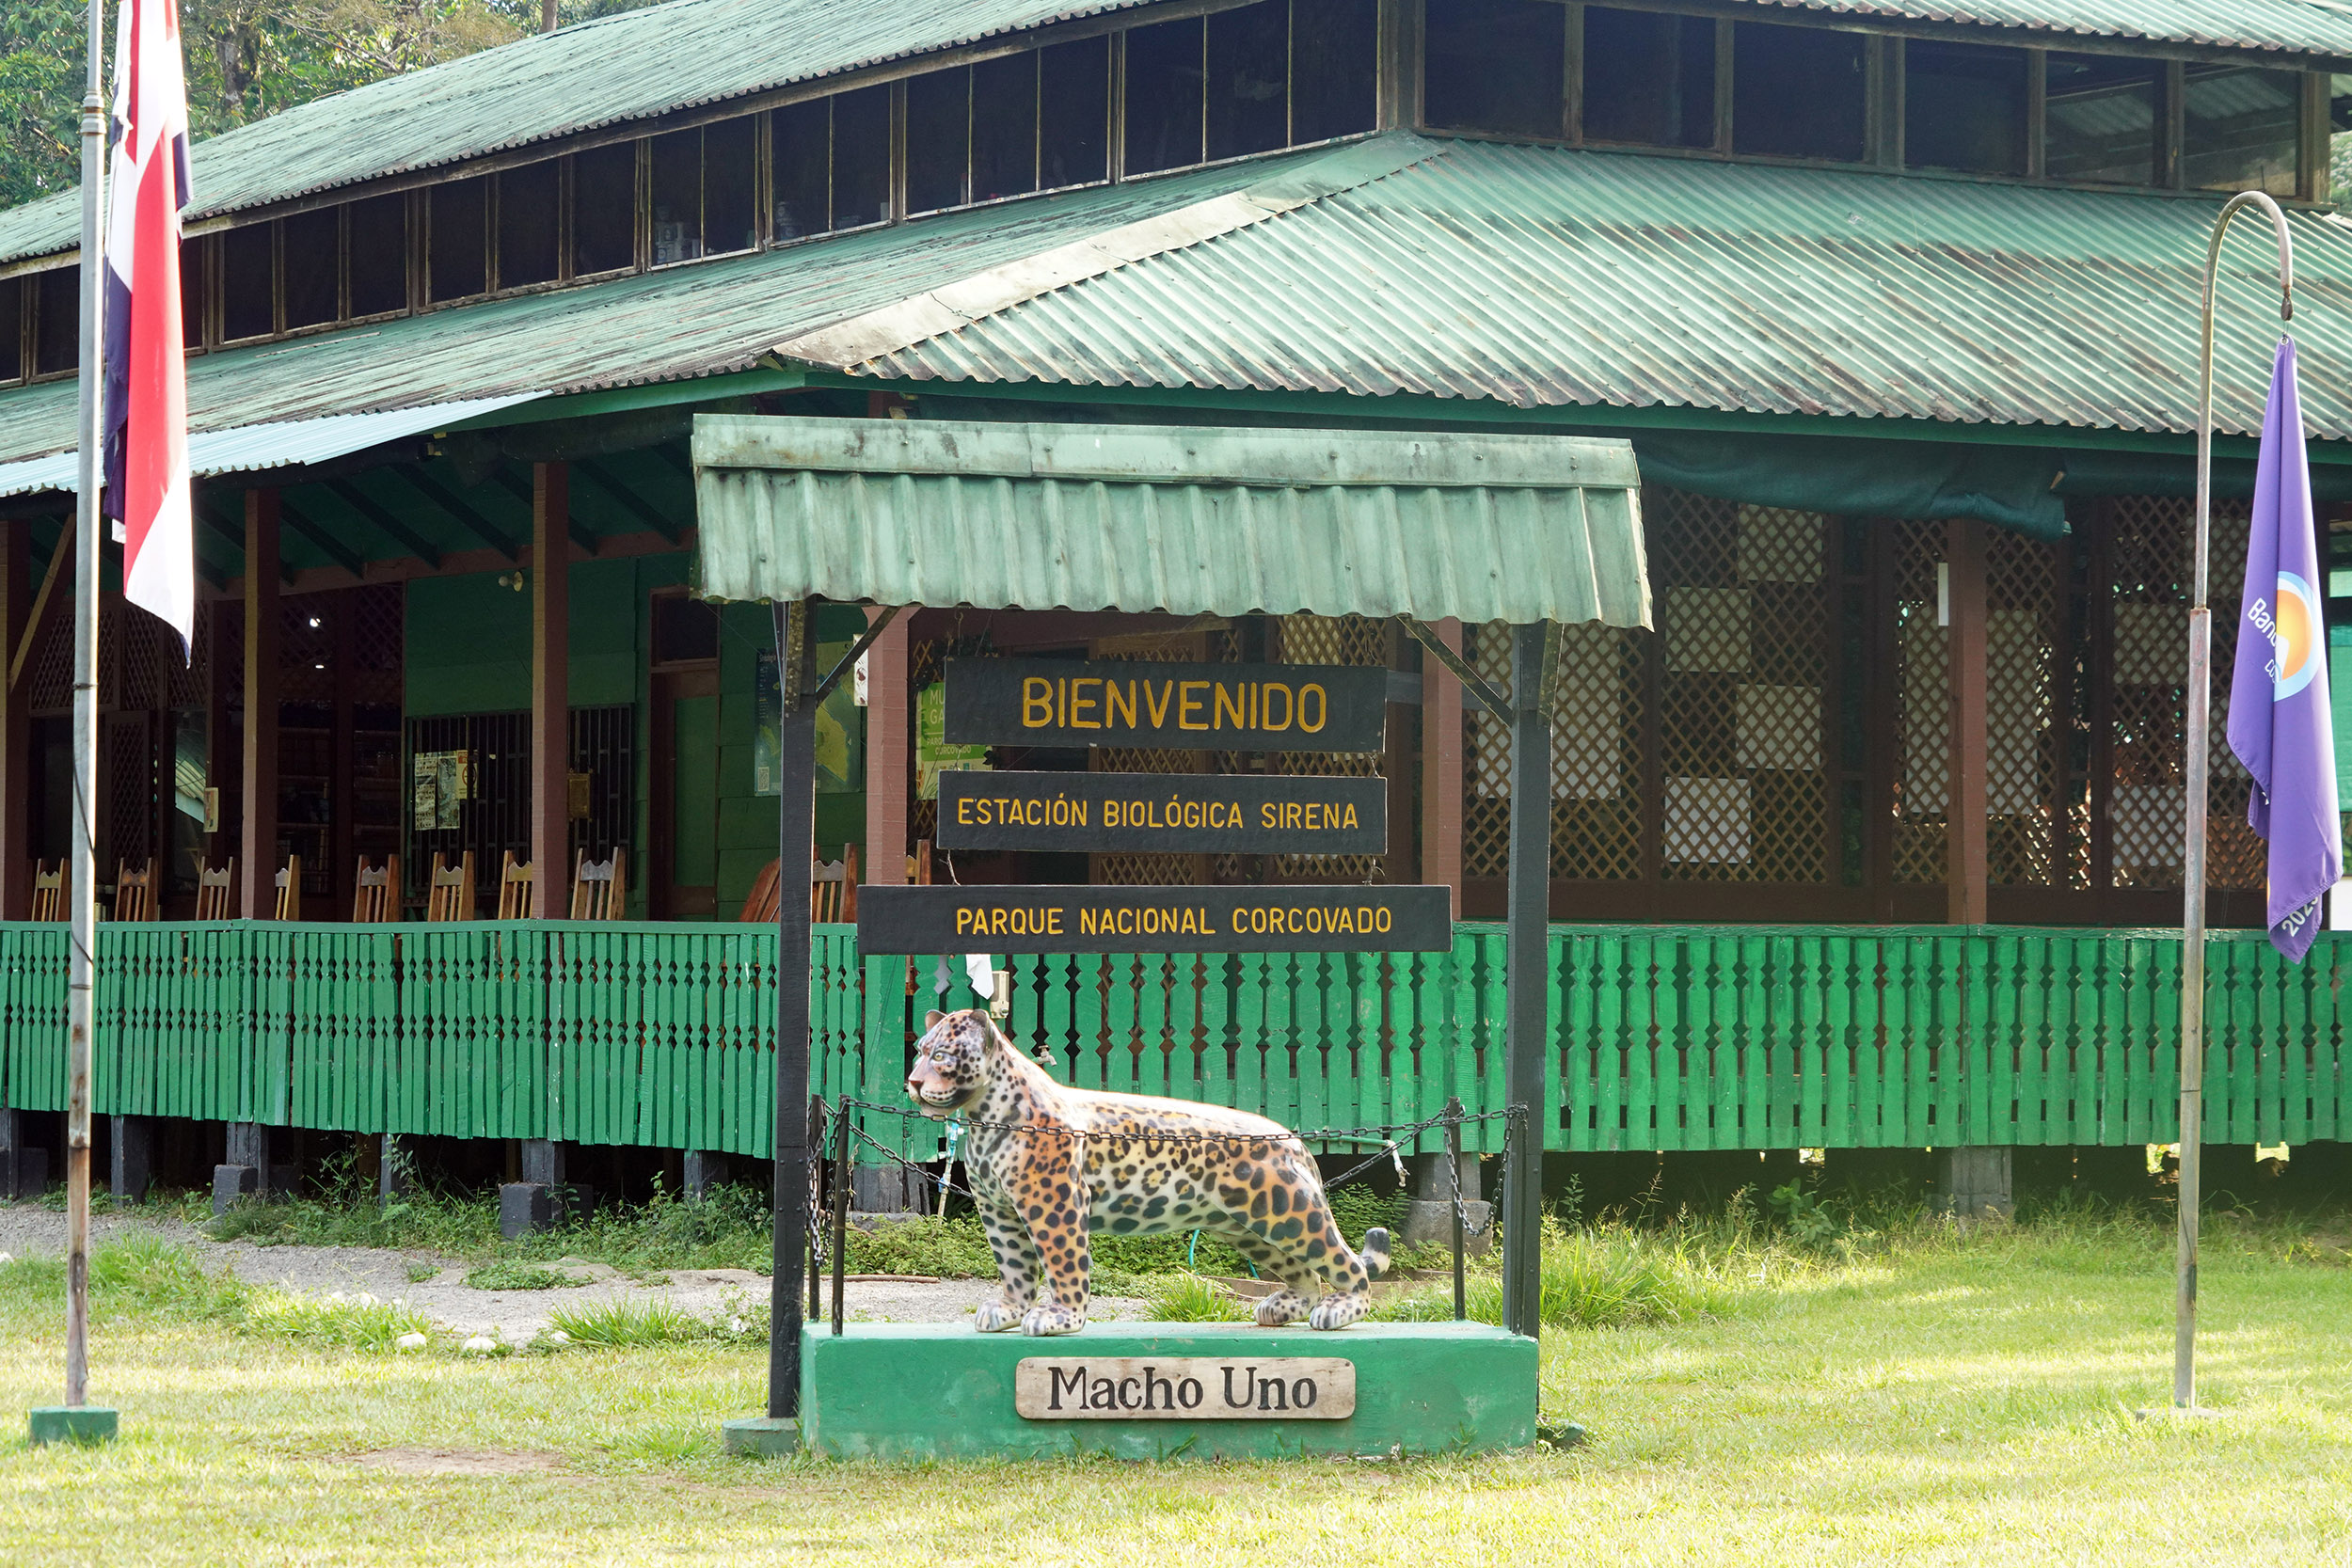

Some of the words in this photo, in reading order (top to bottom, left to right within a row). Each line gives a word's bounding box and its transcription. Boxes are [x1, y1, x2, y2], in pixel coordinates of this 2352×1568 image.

[1022, 677, 1327, 734] BIENVENIDO
[958, 792, 1088, 827] ESTACIÓN
[1103, 793, 1244, 829] BIOLÓGICA
[1261, 801, 1359, 830] SIRENA
[956, 907, 1064, 936] PARQUE
[1080, 907, 1216, 936] NACIONAL
[1232, 906, 1392, 934] CORCOVADO
[1047, 1366, 1204, 1411] Macho
[1220, 1366, 1317, 1411] Uno
